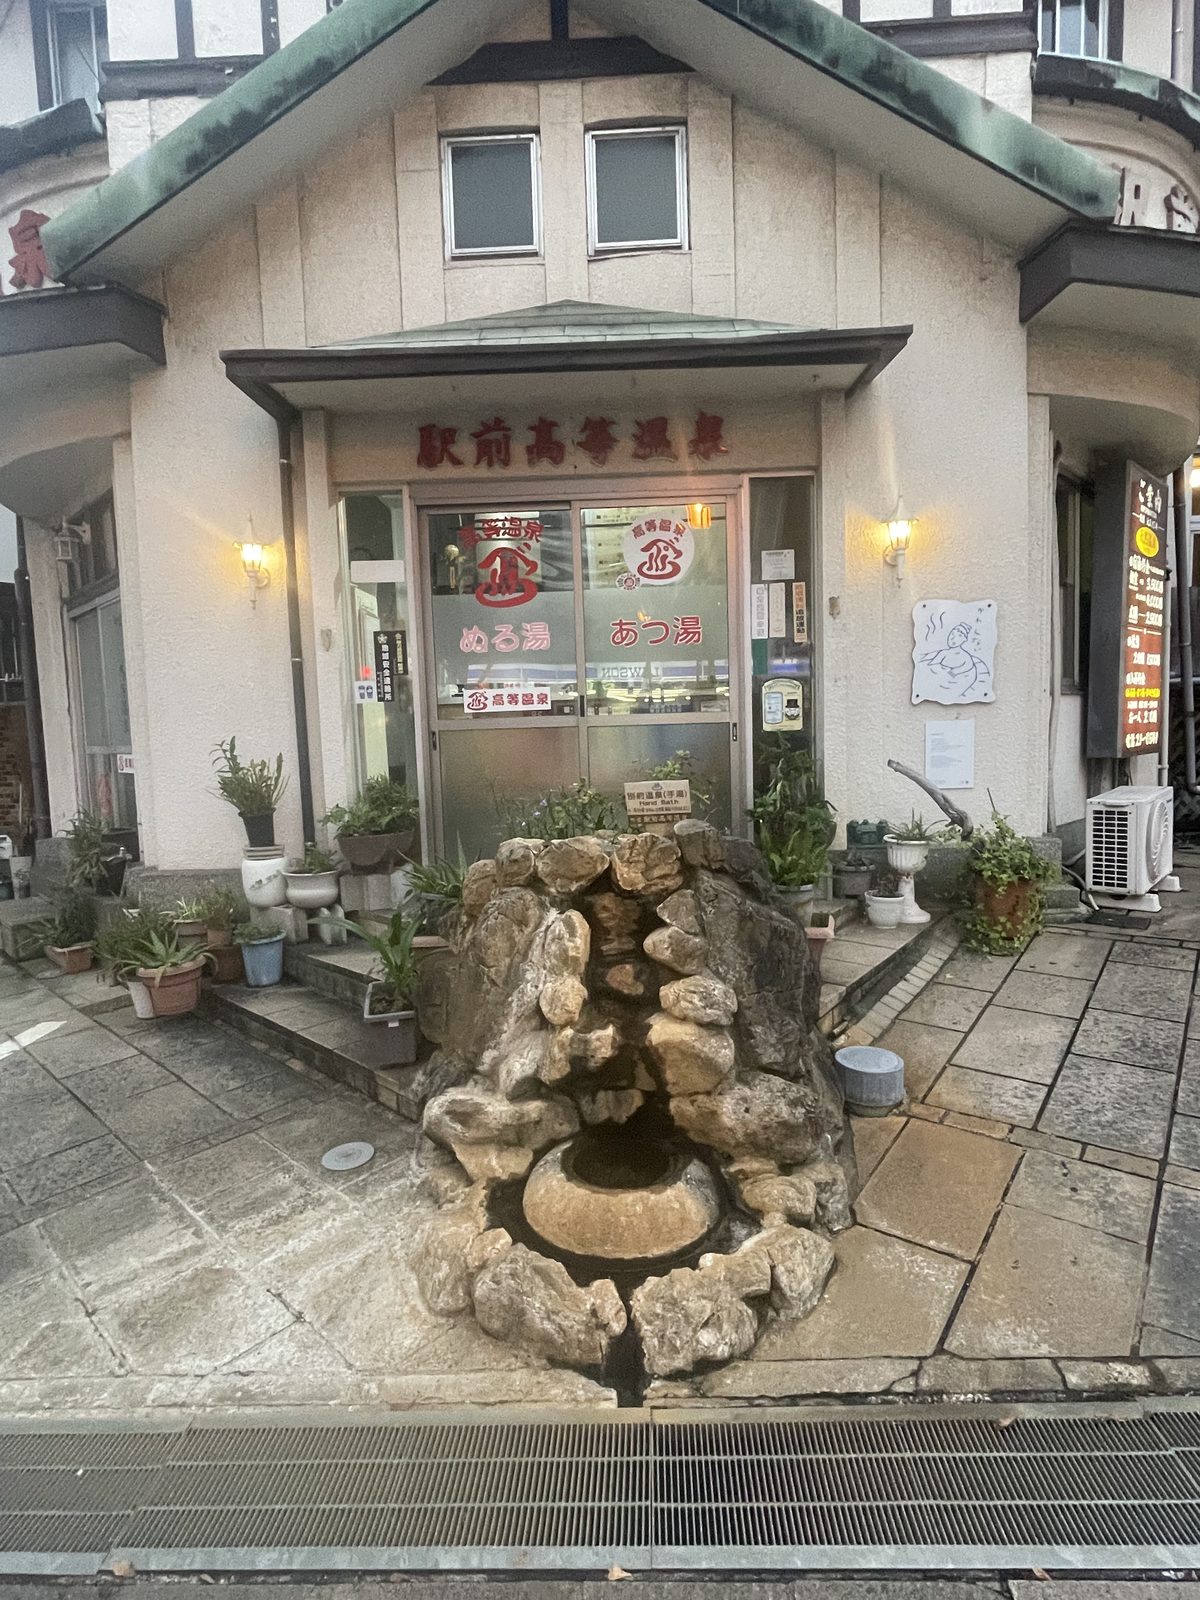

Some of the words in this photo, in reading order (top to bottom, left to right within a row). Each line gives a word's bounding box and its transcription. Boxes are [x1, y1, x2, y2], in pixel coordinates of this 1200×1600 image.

[417, 411, 728, 467] 駅前高等温泉
[457, 516, 545, 550] 高等温泉
[632, 519, 686, 539] 高等温泉
[459, 622, 551, 654] ぬる湯
[609, 615, 703, 649] あつ湯
[492, 691, 549, 707] 高等温泉
